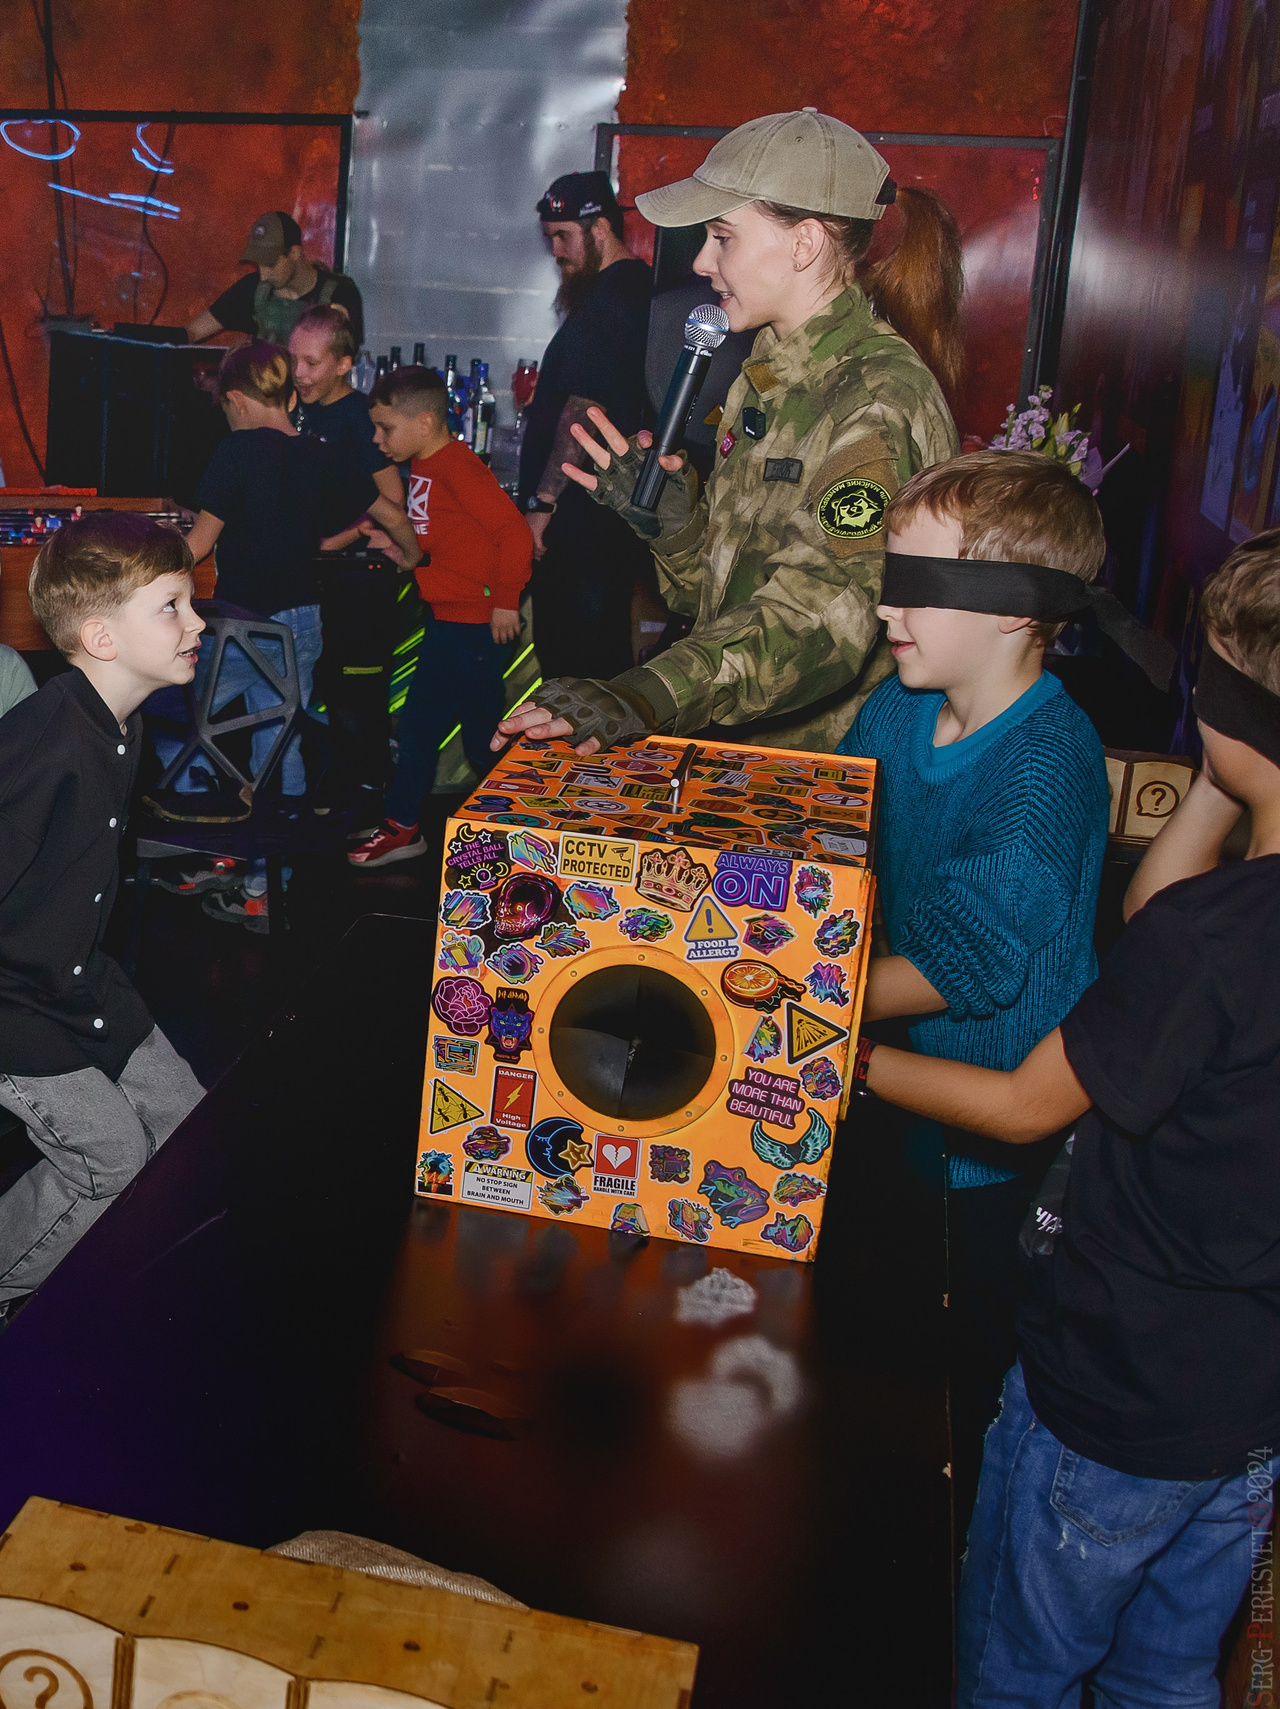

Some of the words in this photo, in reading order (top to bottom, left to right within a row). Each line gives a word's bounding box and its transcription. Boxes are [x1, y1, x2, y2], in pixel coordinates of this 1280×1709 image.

[447, 848, 482, 866] CRYSTAL
[482, 842, 504, 854] BALL
[464, 842, 481, 851] THE
[565, 839, 608, 859] CCTV
[457, 857, 482, 869] TELLS
[483, 852, 499, 861] ALL
[715, 853, 790, 875] ALWAYS
[562, 858, 630, 879] PROTECTED
[713, 869, 787, 909] ON
[696, 939, 726, 949] FOOD
[688, 947, 737, 959] ALLERGY
[498, 1069, 534, 1080] DANGER
[748, 1068, 772, 1086] YOU
[772, 1078, 798, 1094] ARE
[732, 1082, 769, 1103] MORE
[770, 1092, 802, 1112] THAN
[502, 1112, 521, 1121] High
[729, 1098, 794, 1127] BEAUTIFUL
[495, 1118, 527, 1128] Voltage
[481, 1165, 527, 1180] WARNING
[476, 1176, 486, 1184] NO
[486, 1178, 503, 1186] STOP
[503, 1180, 518, 1189] SIGN
[481, 1185, 511, 1195] BETWEEN
[593, 1175, 637, 1191] FRAGILE
[466, 1190, 486, 1199] BRAIN
[486, 1192, 500, 1201] AND
[500, 1195, 524, 1205] MOUTH
[592, 1186, 610, 1194] HANDLE
[610, 1188, 623, 1196] WITH
